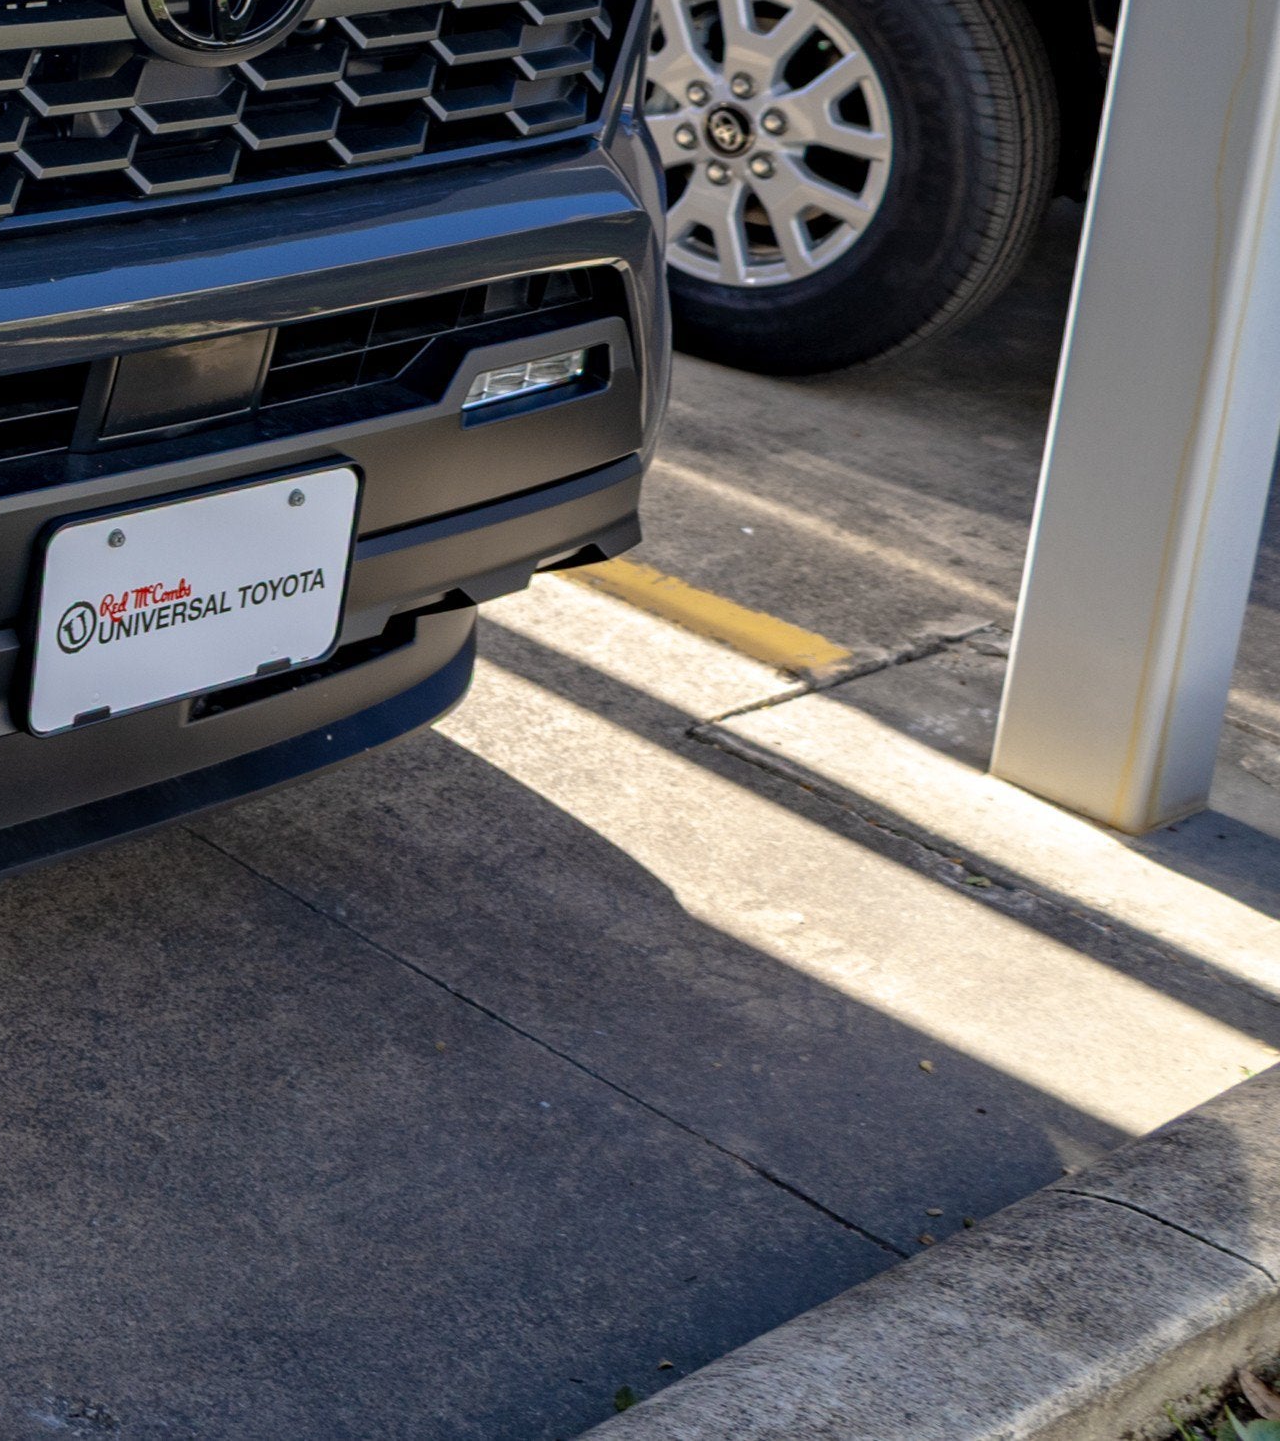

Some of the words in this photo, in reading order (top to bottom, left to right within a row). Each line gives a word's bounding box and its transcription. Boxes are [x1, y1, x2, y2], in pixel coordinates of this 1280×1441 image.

[98, 591, 232, 645] UNIVERSAL
[238, 568, 325, 608] TOYOTA
[100, 593, 129, 622] Red
[131, 578, 191, 609] McCombs
